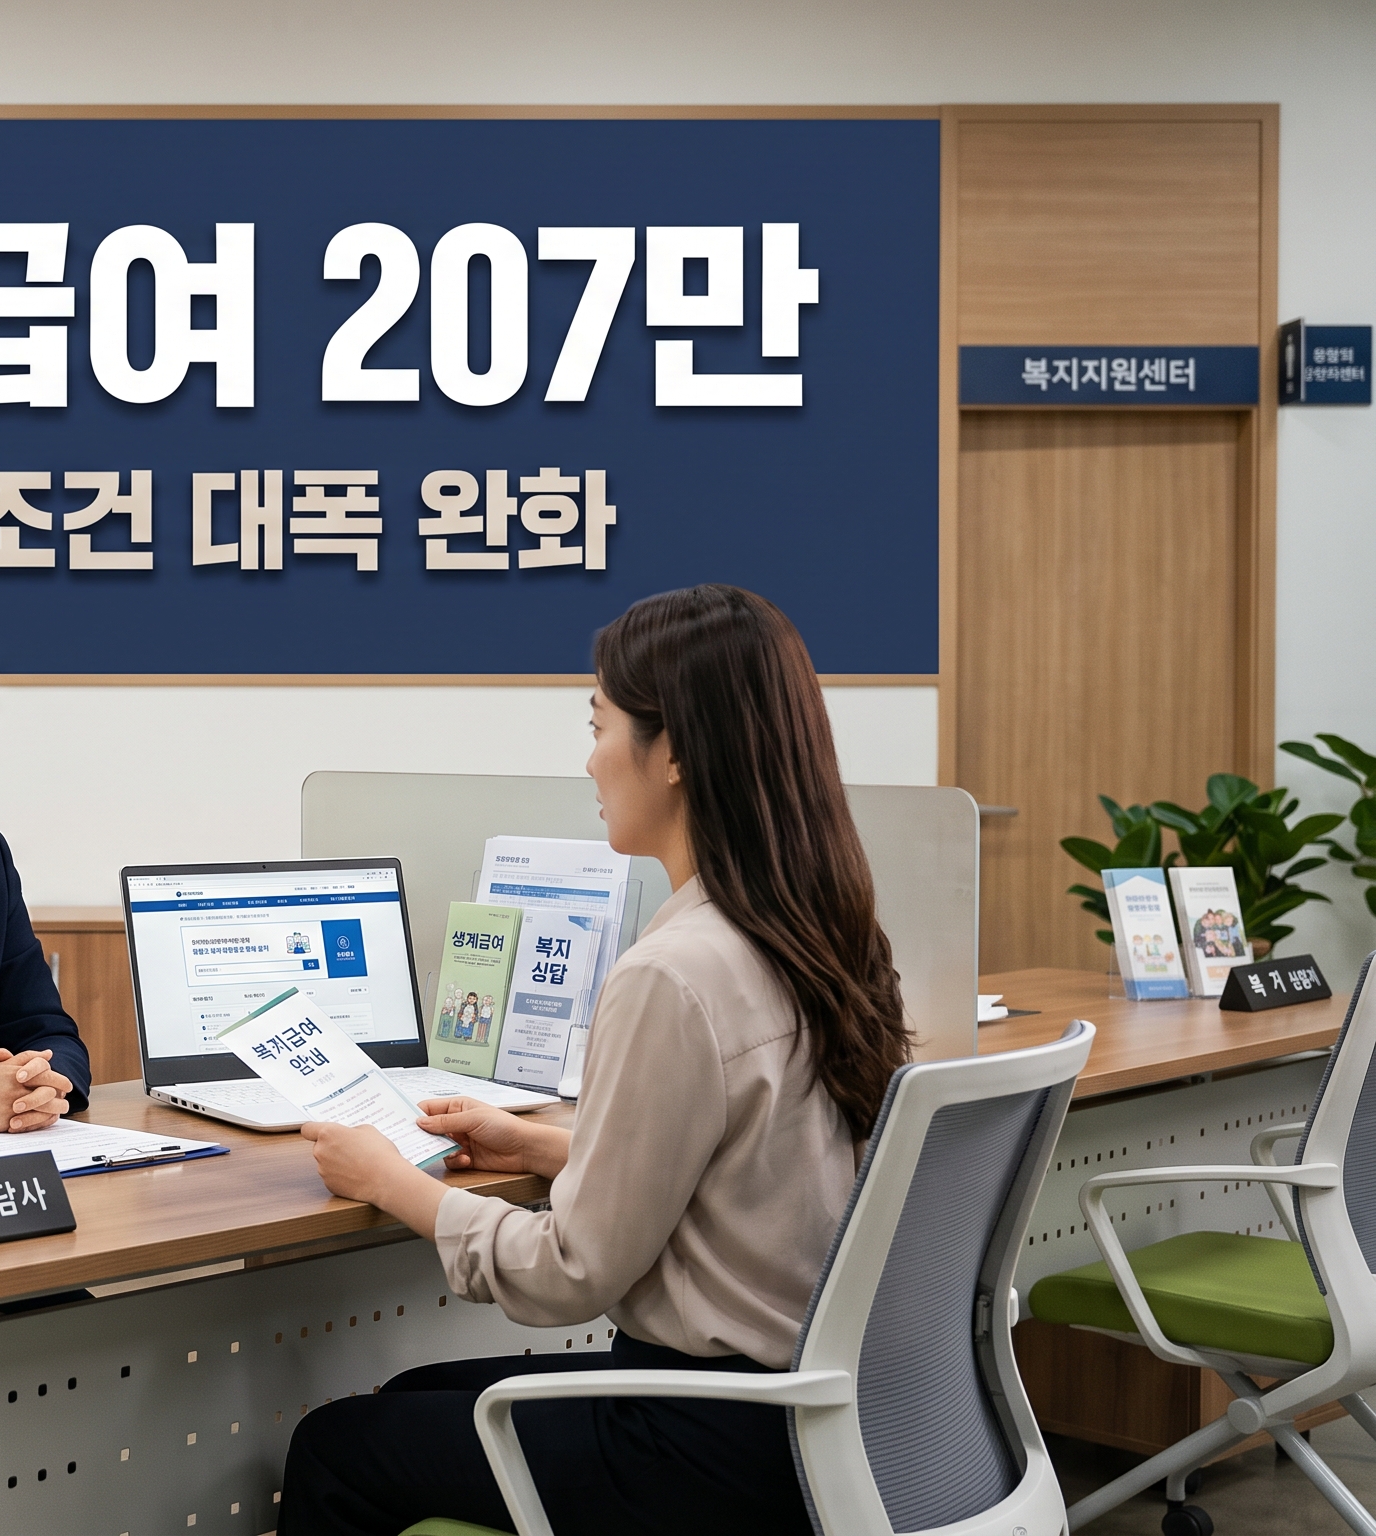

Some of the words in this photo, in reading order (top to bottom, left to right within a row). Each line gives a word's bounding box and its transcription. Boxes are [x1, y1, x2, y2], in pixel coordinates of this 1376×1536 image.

[321, 222, 820, 408] 207만
[1020, 356, 1196, 391] 복지지원센터
[192, 469, 383, 571] 대폭
[418, 467, 617, 570] 완화
[452, 930, 505, 952] 생계급여
[535, 936, 572, 960] 복지
